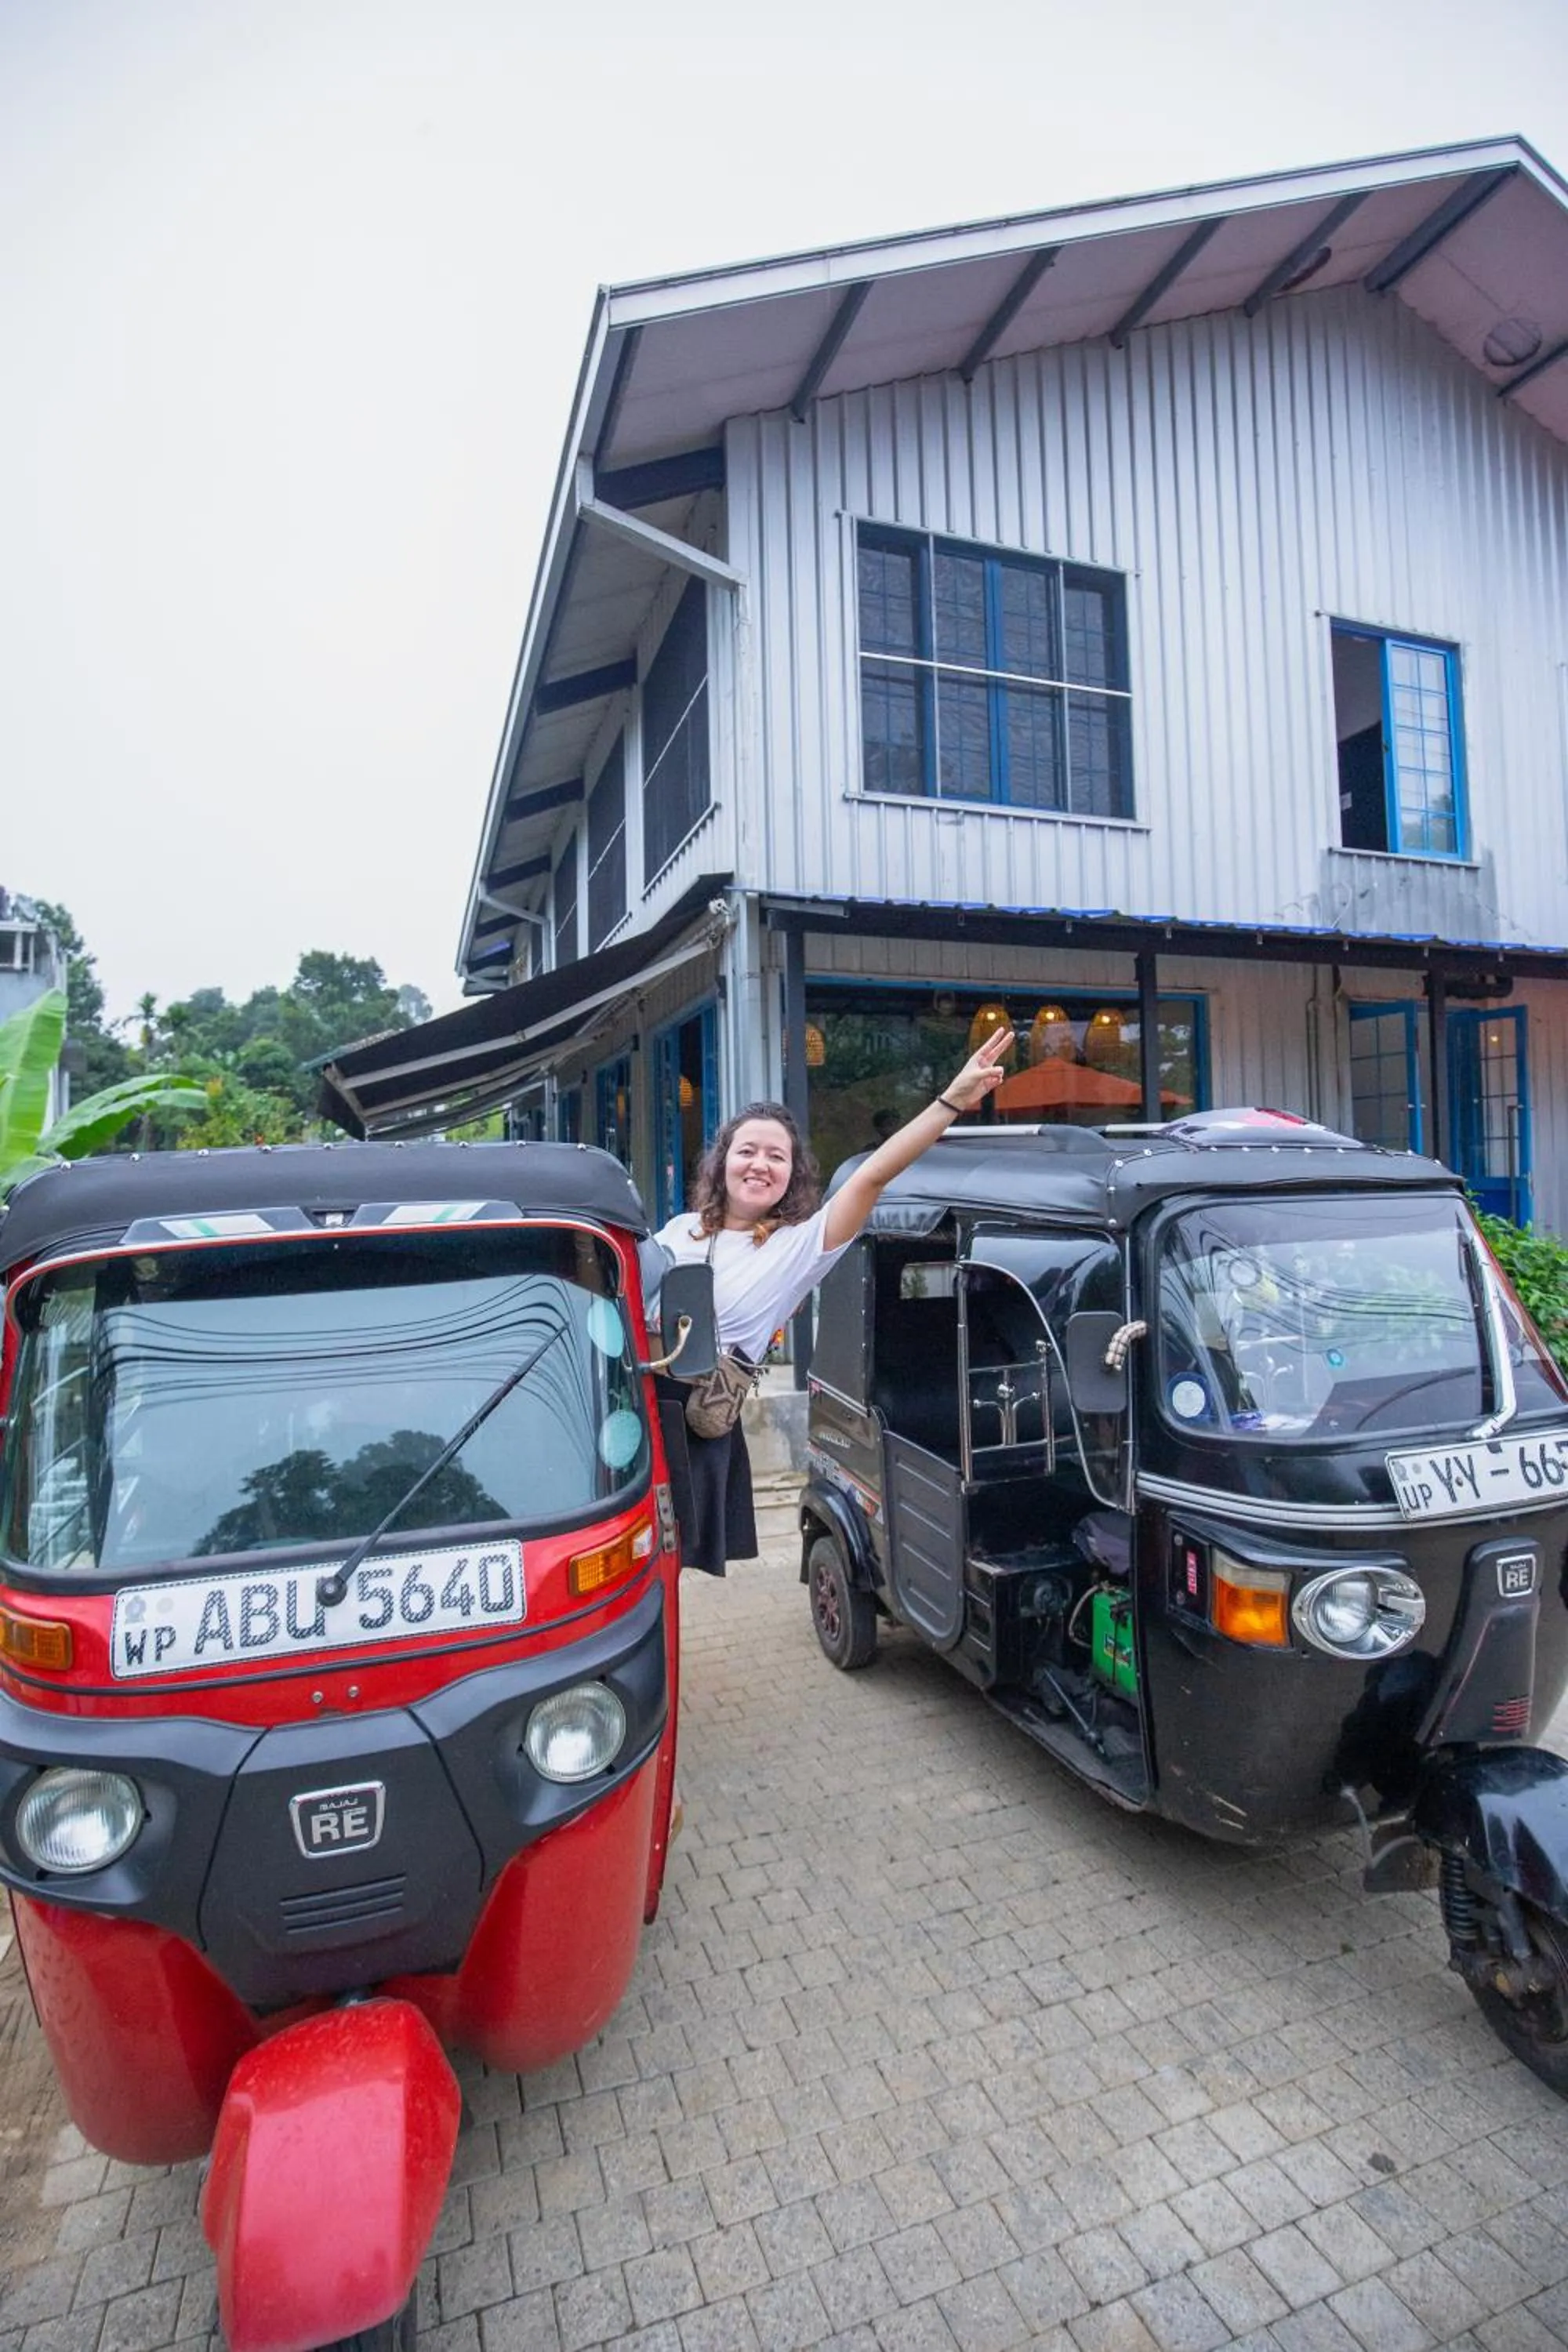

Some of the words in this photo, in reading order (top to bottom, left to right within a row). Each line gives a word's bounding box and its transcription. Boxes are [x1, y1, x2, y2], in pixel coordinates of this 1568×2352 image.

[1403, 1483, 1432, 1510] UP
[1506, 1569, 1529, 1589] RE
[125, 1626, 176, 1666] WP
[194, 1579, 325, 1654] ABU
[358, 1554, 514, 1630] 5640
[311, 1806, 369, 1844] RE
